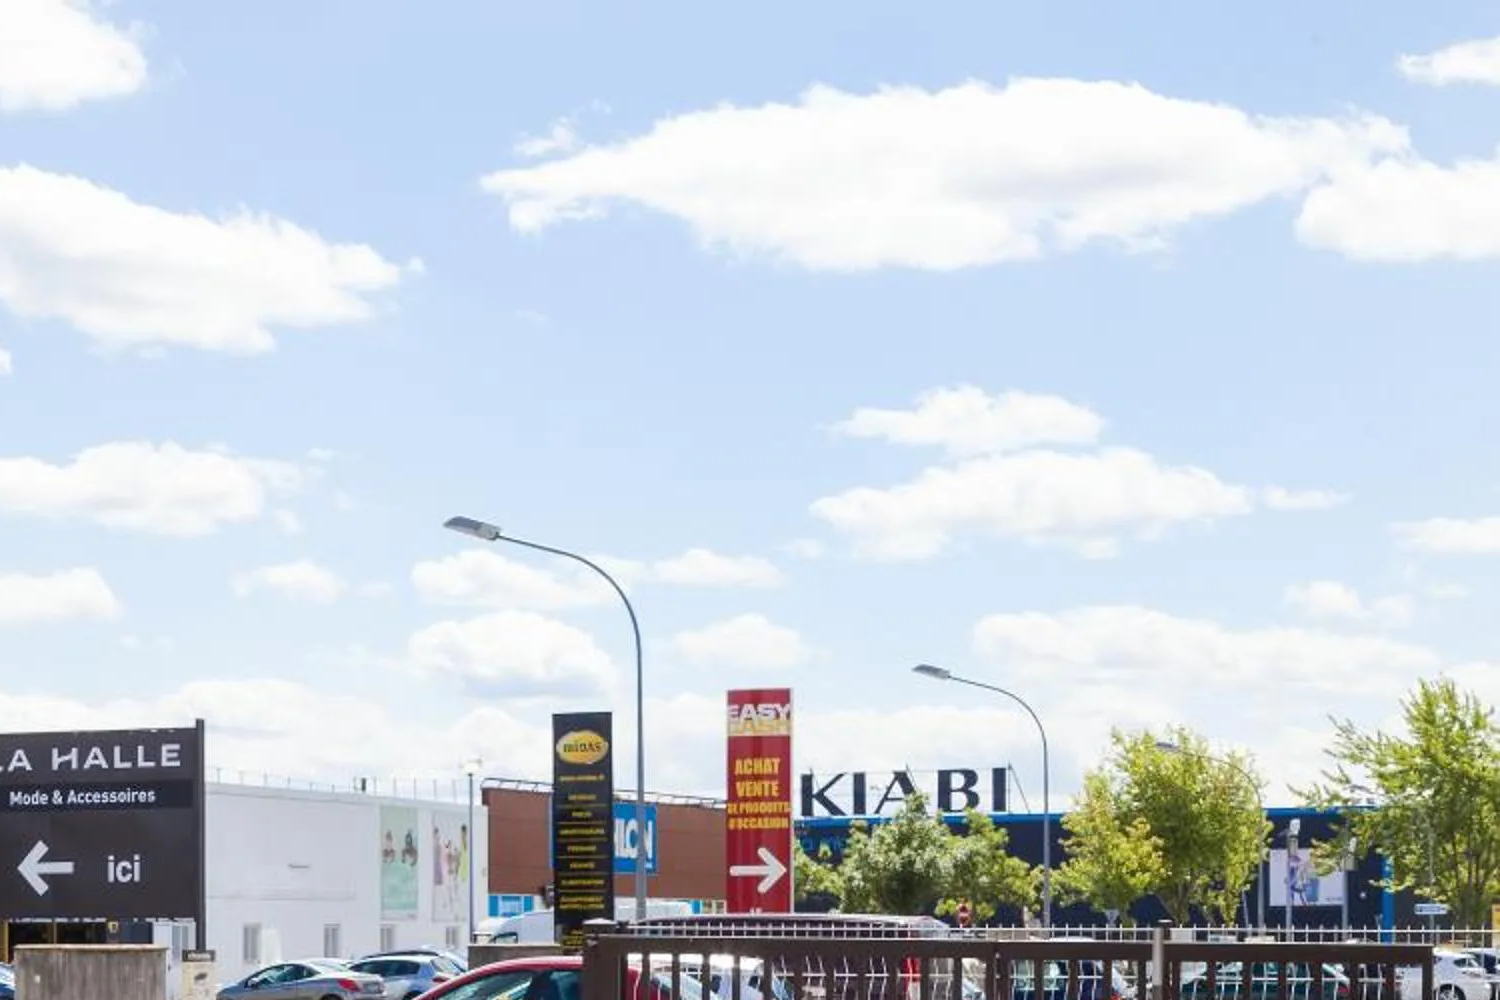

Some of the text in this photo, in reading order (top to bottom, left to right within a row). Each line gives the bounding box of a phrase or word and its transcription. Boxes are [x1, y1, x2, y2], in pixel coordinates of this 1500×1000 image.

[727, 703, 790, 722] EASY
[51, 743, 181, 771] HALLE
[734, 757, 781, 776] ACHAT
[9, 787, 157, 806] Mode & Accessoires
[735, 779, 780, 798] VENTE
[800, 767, 1008, 816] KIABI
[107, 854, 141, 883] ici
